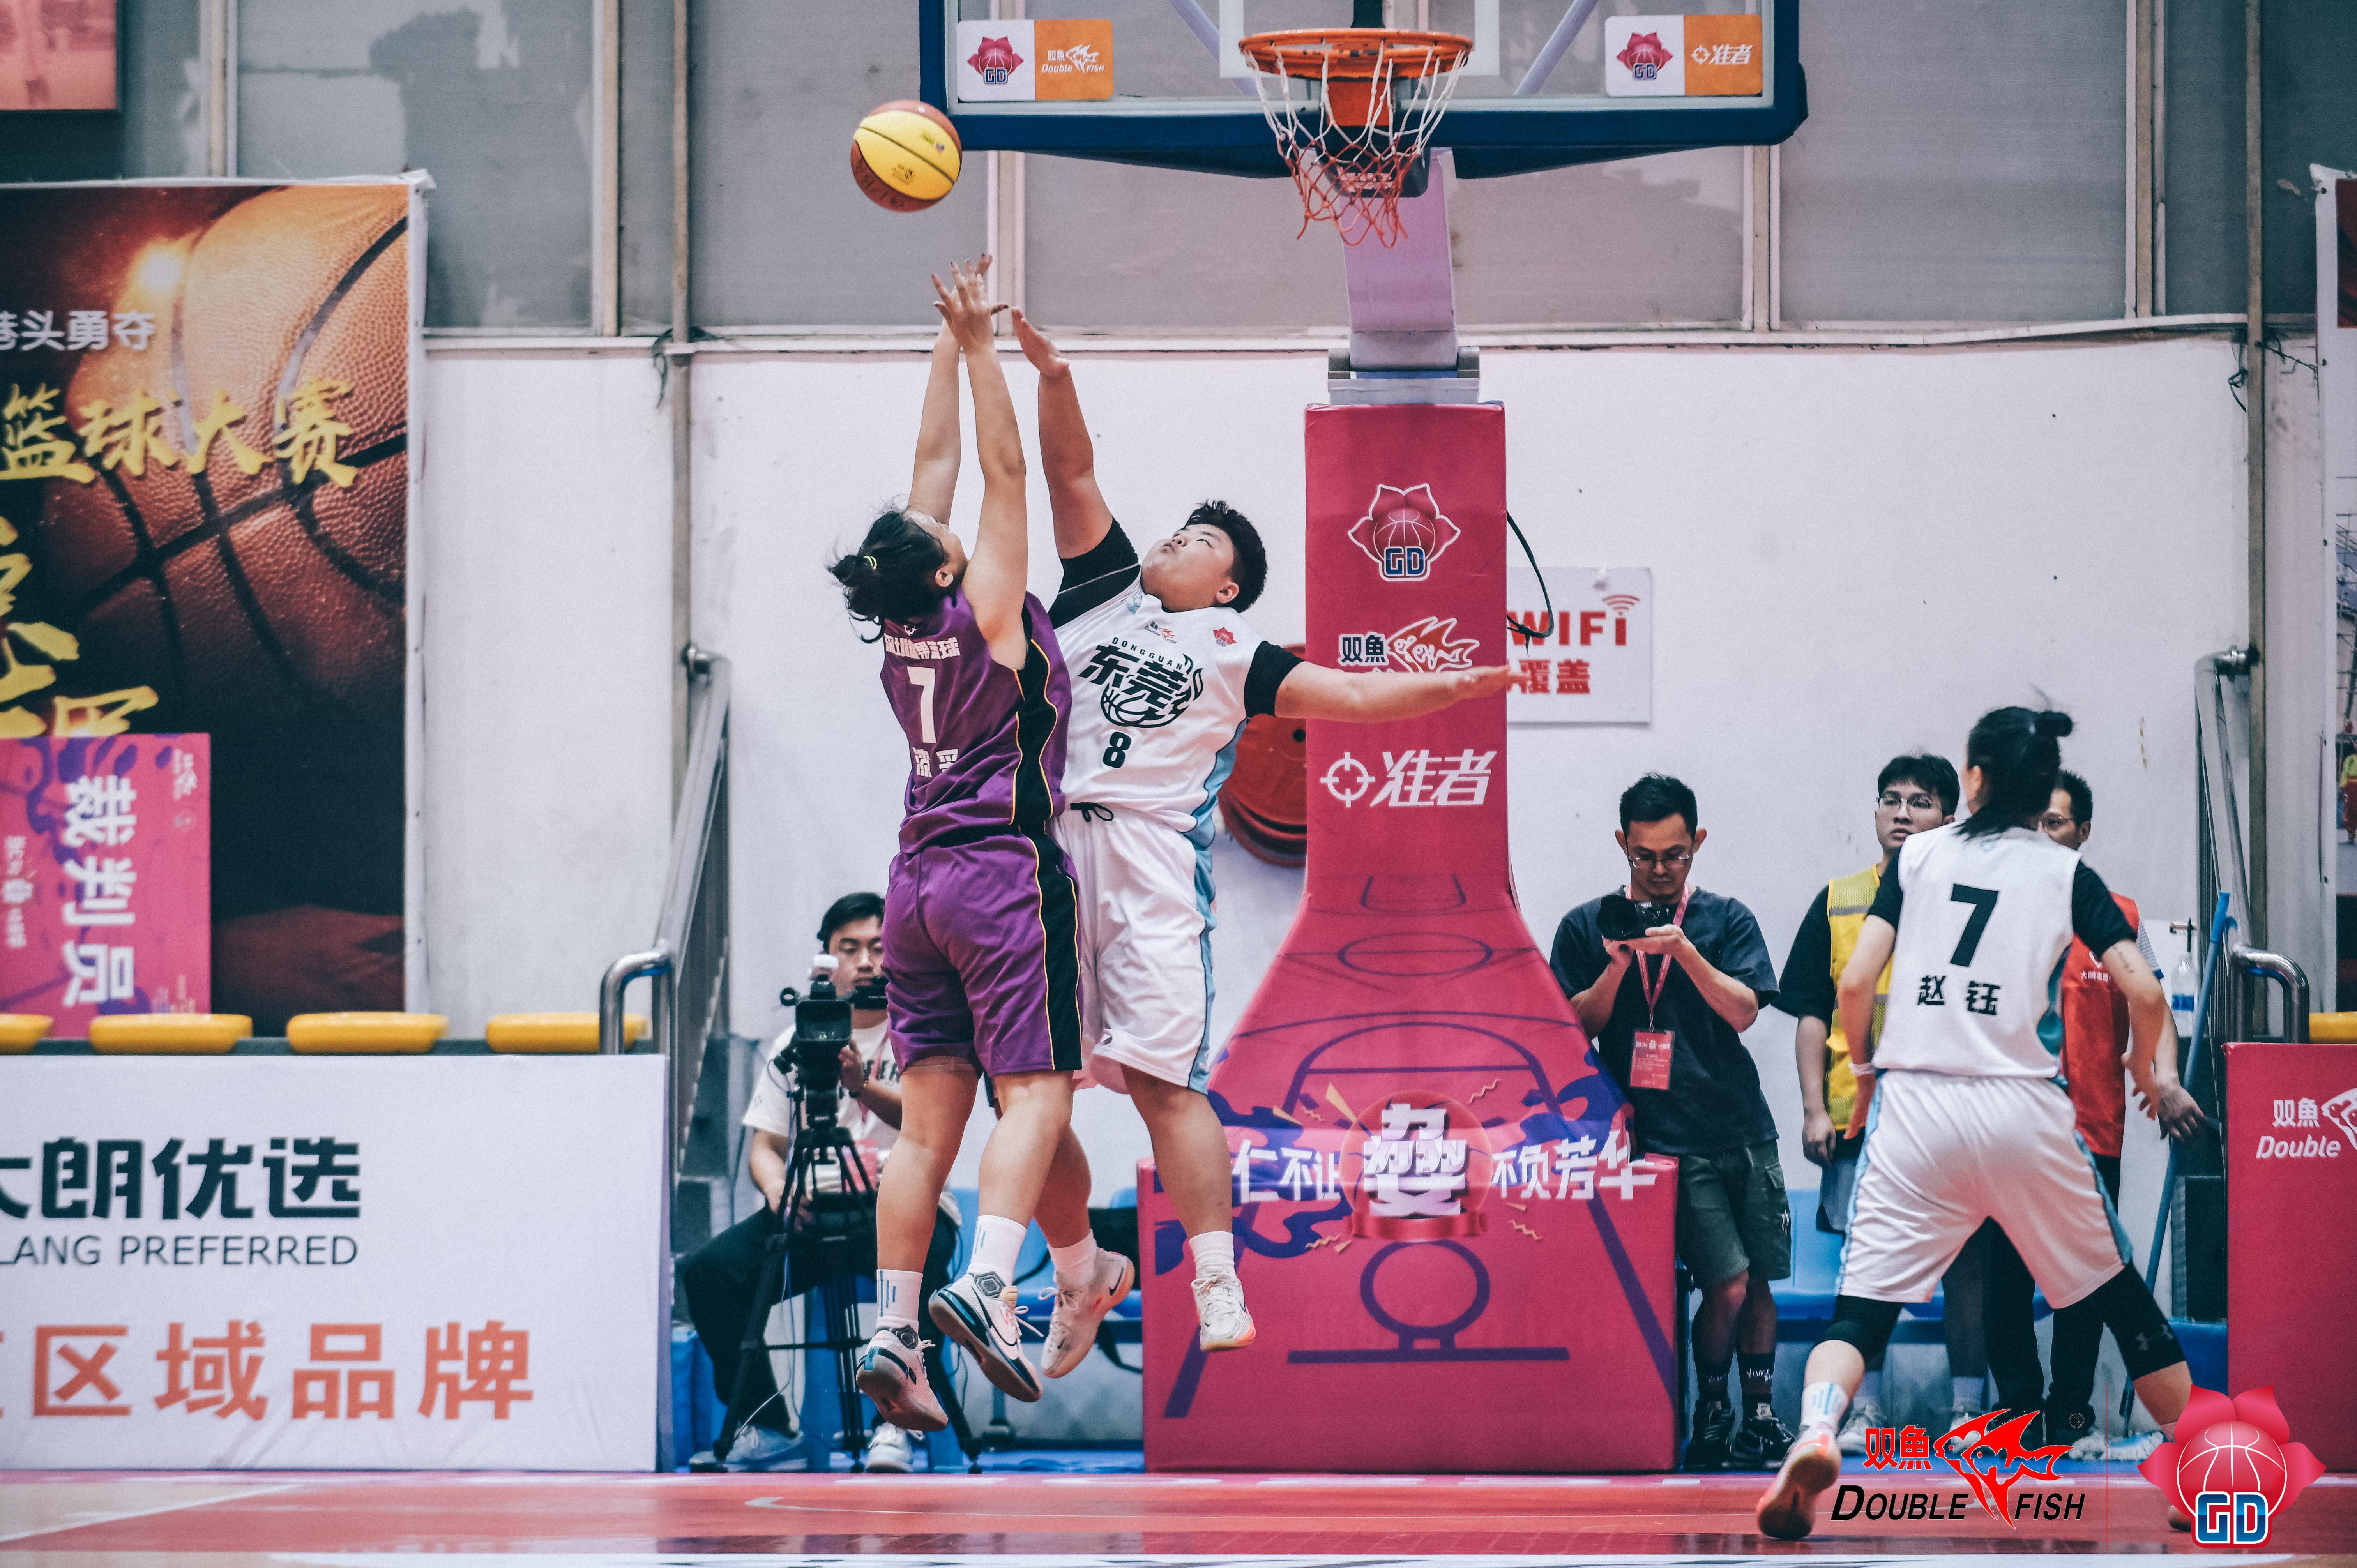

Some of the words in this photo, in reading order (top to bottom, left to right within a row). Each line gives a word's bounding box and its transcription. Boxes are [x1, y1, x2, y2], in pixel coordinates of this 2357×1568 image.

[1041, 63, 1073, 73] Double
[1086, 64, 1105, 73] FISH
[1710, 44, 1753, 65] 准者
[0, 379, 358, 488] 篮球大赛
[1385, 547, 1426, 576] GD
[1112, 637, 1183, 670] DONGGUAN
[1341, 635, 1386, 663] 双魚
[1078, 645, 1188, 711] 东莞
[1507, 659, 1590, 694] 覆盖
[907, 666, 937, 744] 7
[1103, 731, 1131, 768] 8
[1370, 749, 1497, 807] 准者
[62, 775, 137, 1007] 裁判员
[1949, 883, 1999, 967] 7
[2272, 1097, 2320, 1127] 双魚
[1492, 1129, 1658, 1200] 不负芳华
[2256, 1134, 2341, 1159] Double
[1231, 1139, 1341, 1203] 仁不让
[120, 1235, 359, 1266] PREFERRED
[0, 1319, 534, 1421] 区域品牌
